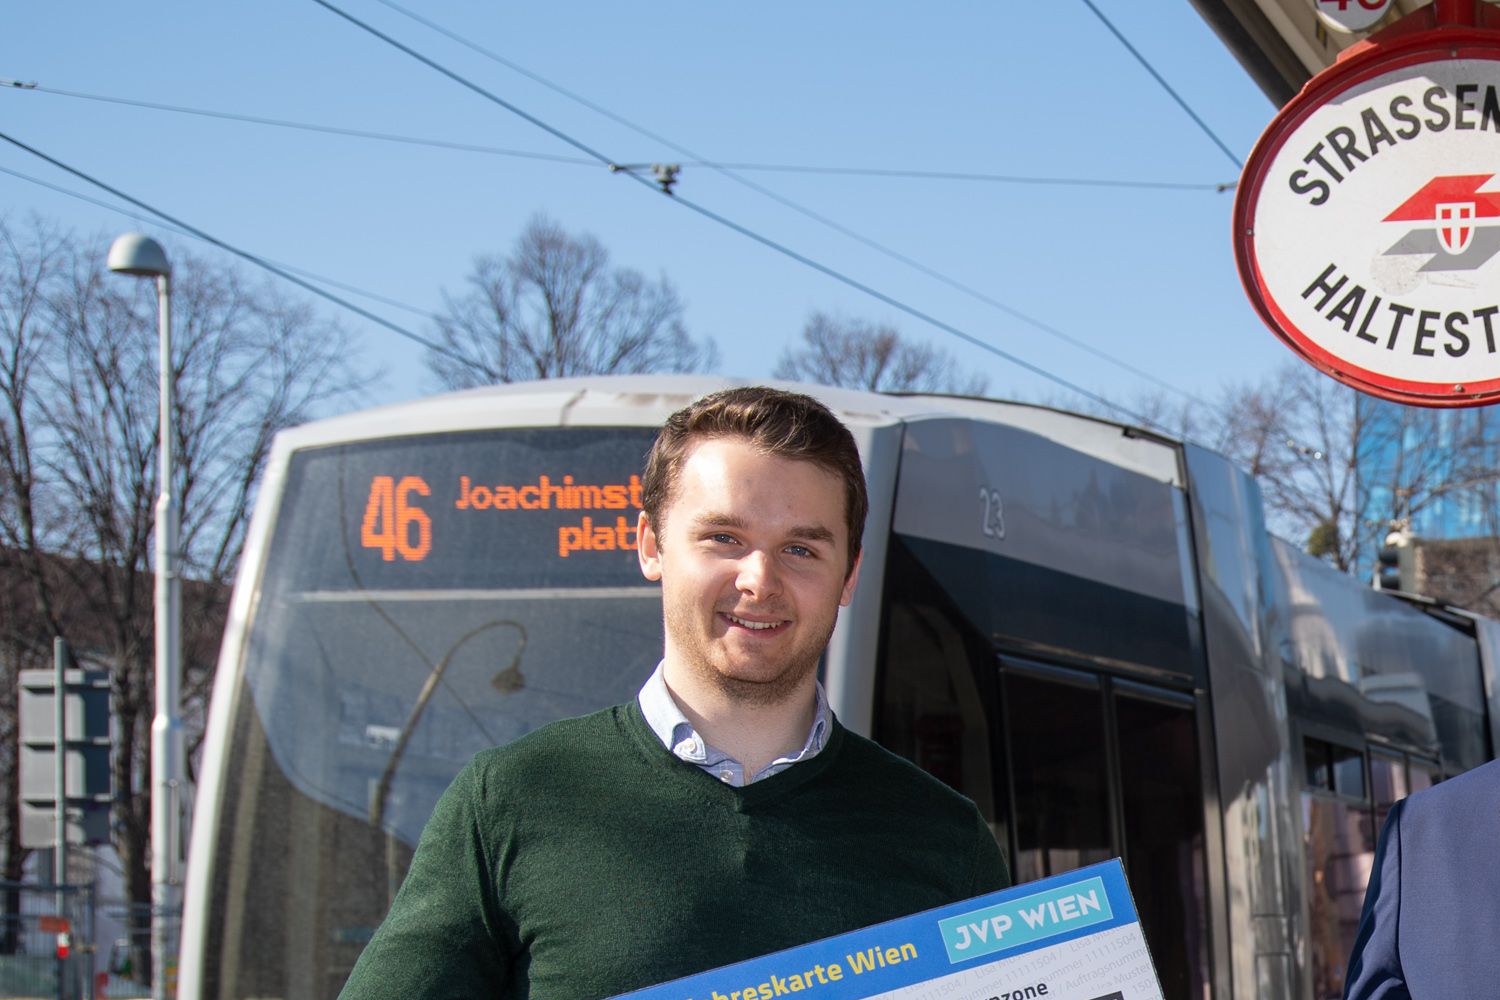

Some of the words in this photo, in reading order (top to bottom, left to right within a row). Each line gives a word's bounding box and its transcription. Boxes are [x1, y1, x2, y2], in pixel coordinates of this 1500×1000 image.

[361, 475, 433, 562] 46
[557, 516, 638, 558] plat
[979, 487, 1006, 541] 23
[954, 914, 1013, 951] JVP
[1017, 889, 1101, 930] WIEN
[846, 942, 918, 975] Wien
